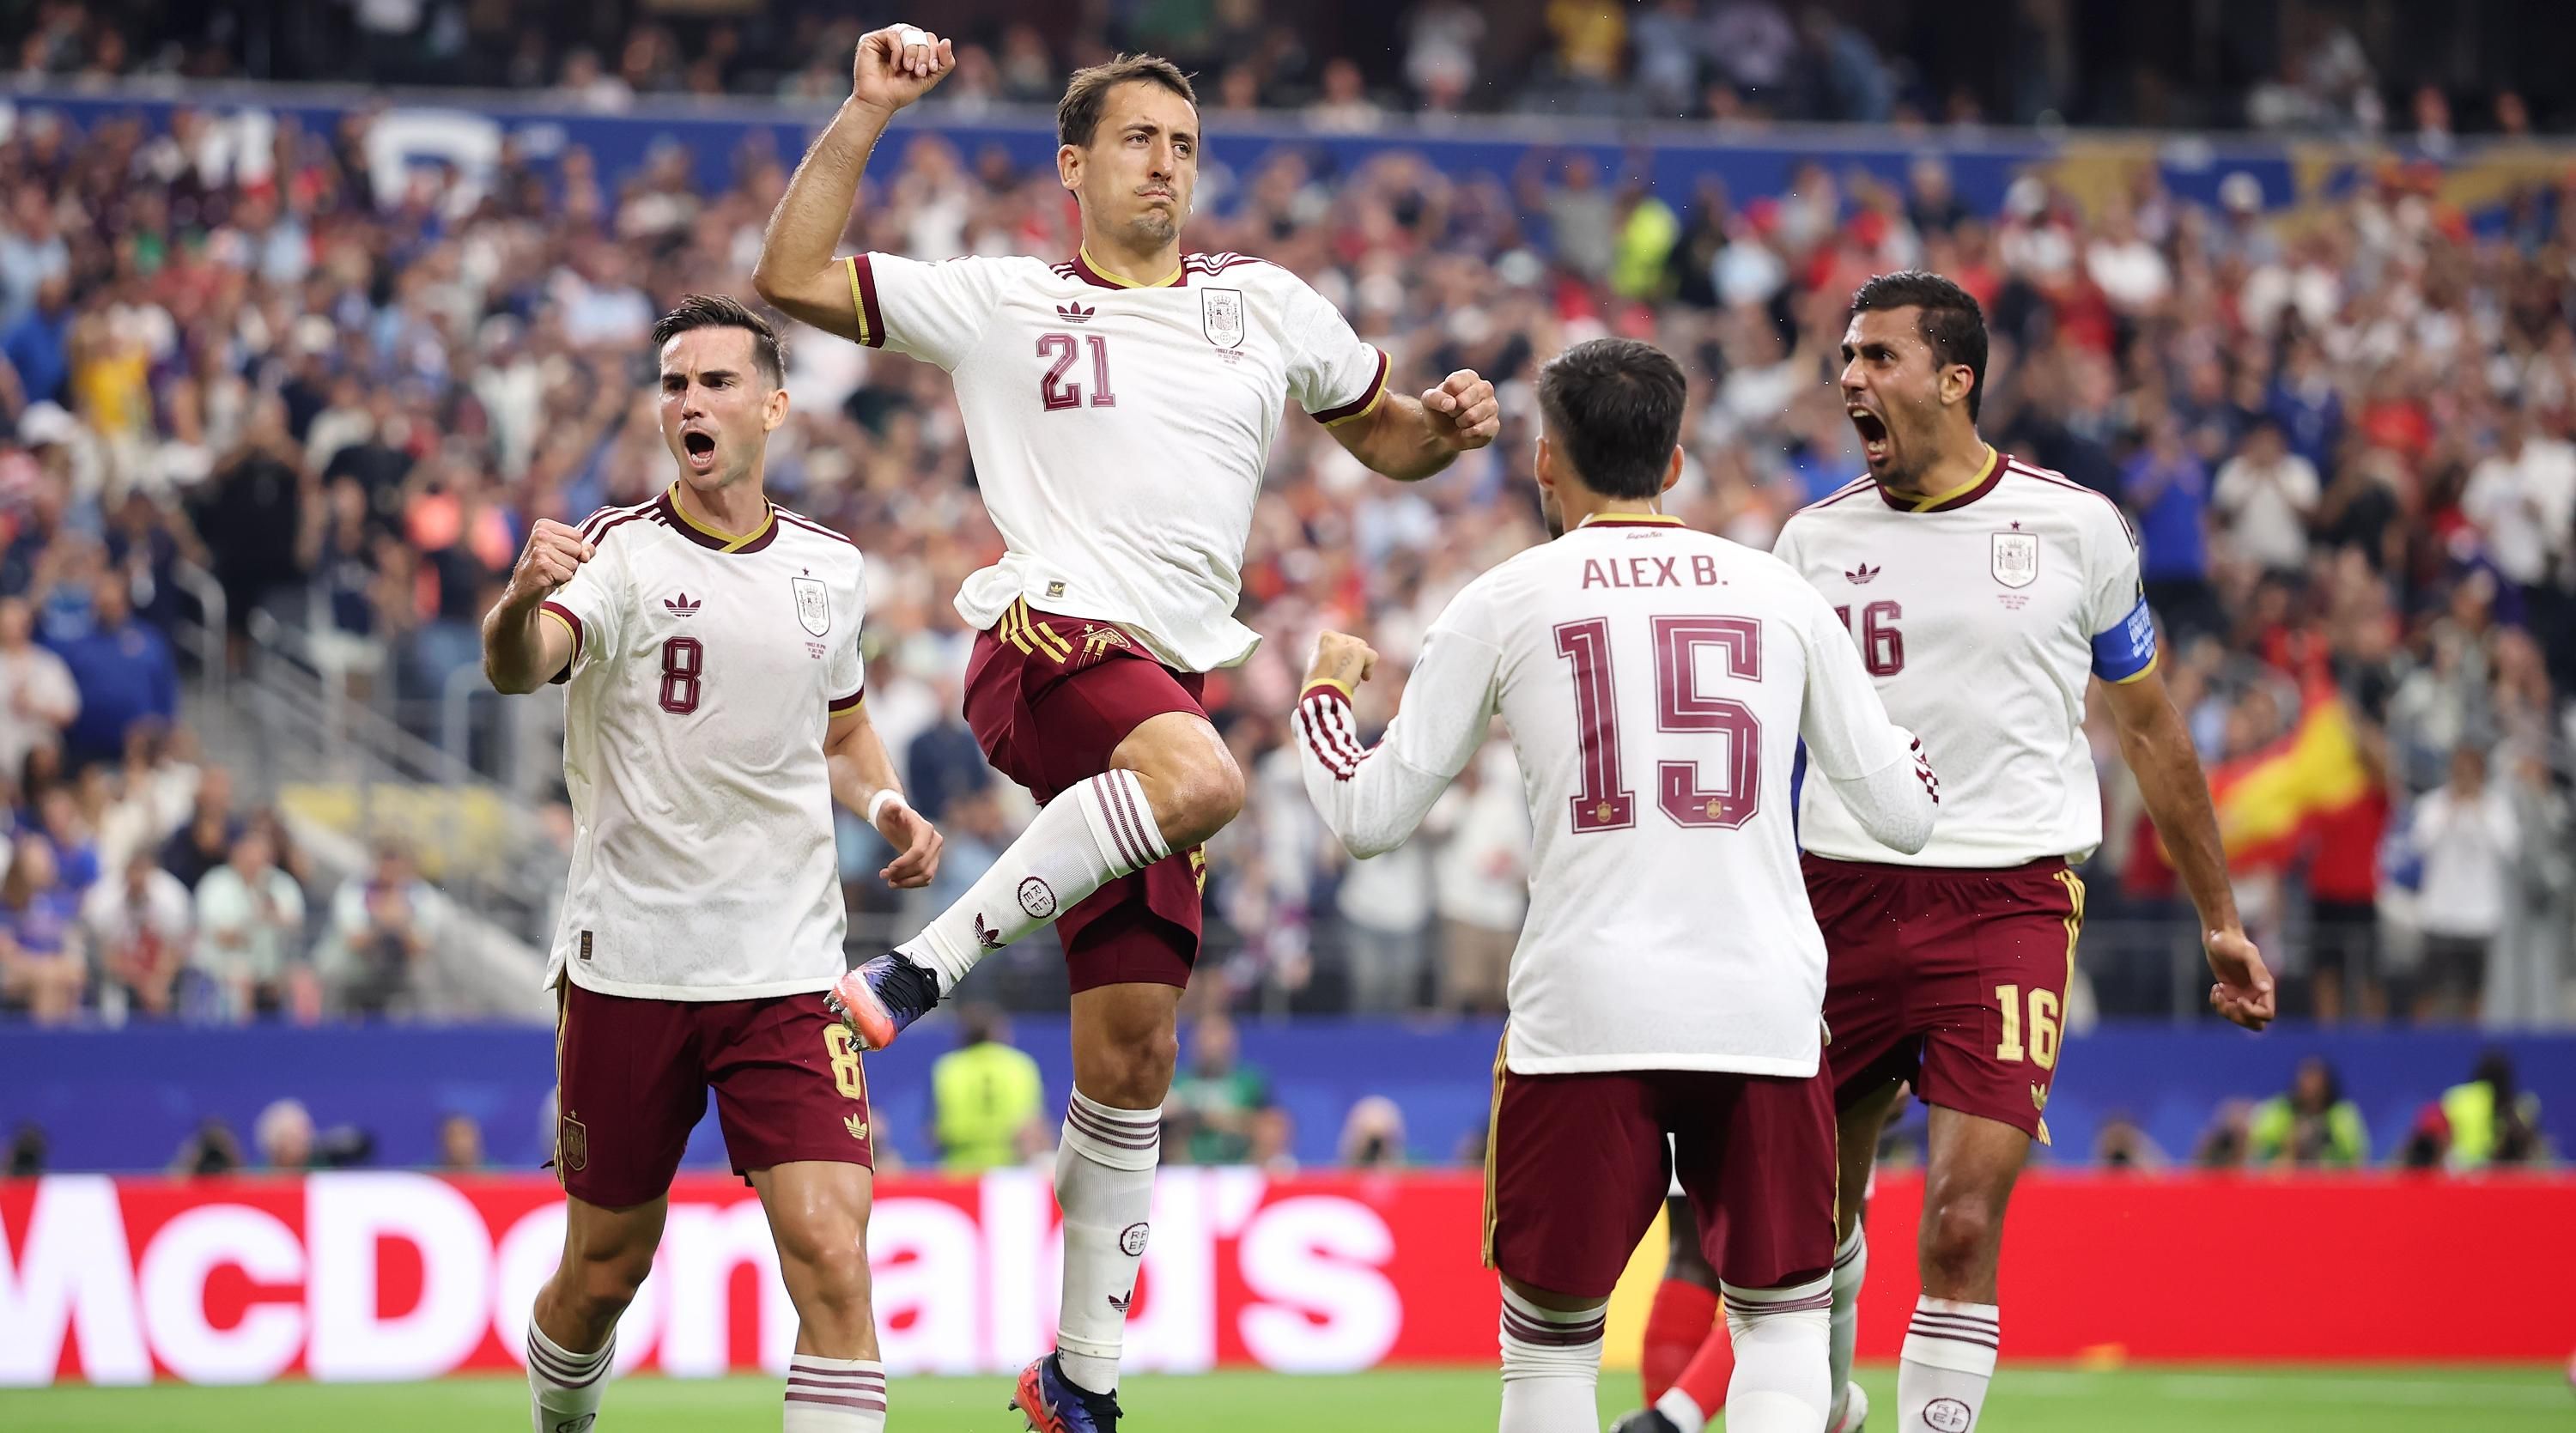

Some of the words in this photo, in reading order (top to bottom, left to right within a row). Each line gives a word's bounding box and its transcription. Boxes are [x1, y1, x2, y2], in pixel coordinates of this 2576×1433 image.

[1036, 332, 1115, 411] 21
[1582, 556, 1681, 590] ALEX
[1691, 555, 1728, 586] B.
[659, 636, 703, 715] 8
[1552, 615, 1762, 835] 15
[823, 1023, 861, 1100] 8
[1995, 984, 2058, 1072] 16
